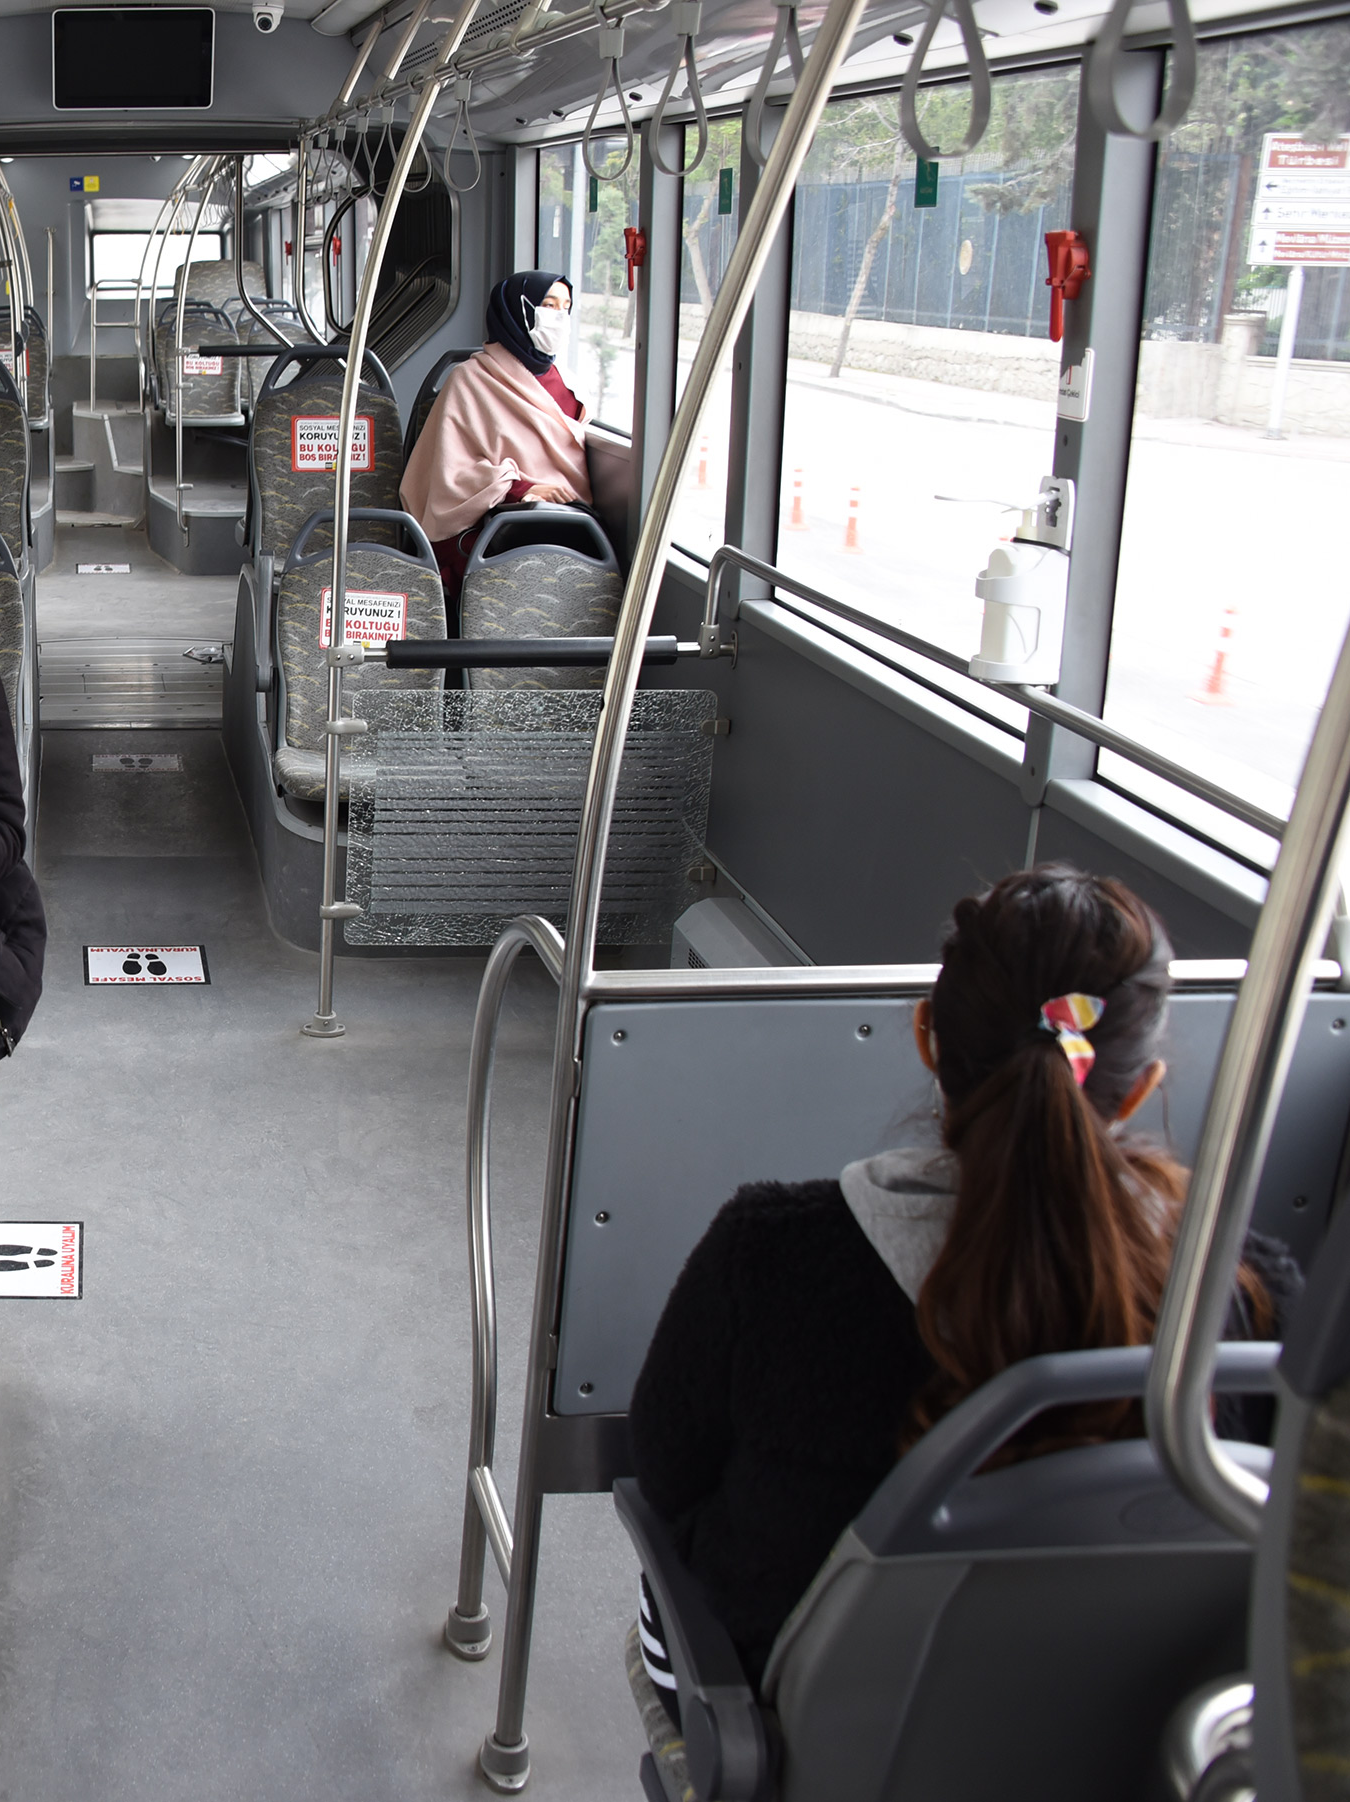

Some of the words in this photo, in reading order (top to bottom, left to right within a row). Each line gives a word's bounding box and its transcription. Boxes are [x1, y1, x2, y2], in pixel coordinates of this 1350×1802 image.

[299, 444, 314, 452] BU
[327, 605, 394, 618] KRUYUNUZ
[345, 619, 400, 632] KOLTUĞU
[346, 630, 394, 641] BIRAKINIZ
[62, 1225, 76, 1253] UYALIM
[60, 1254, 75, 1294] KURALINA
